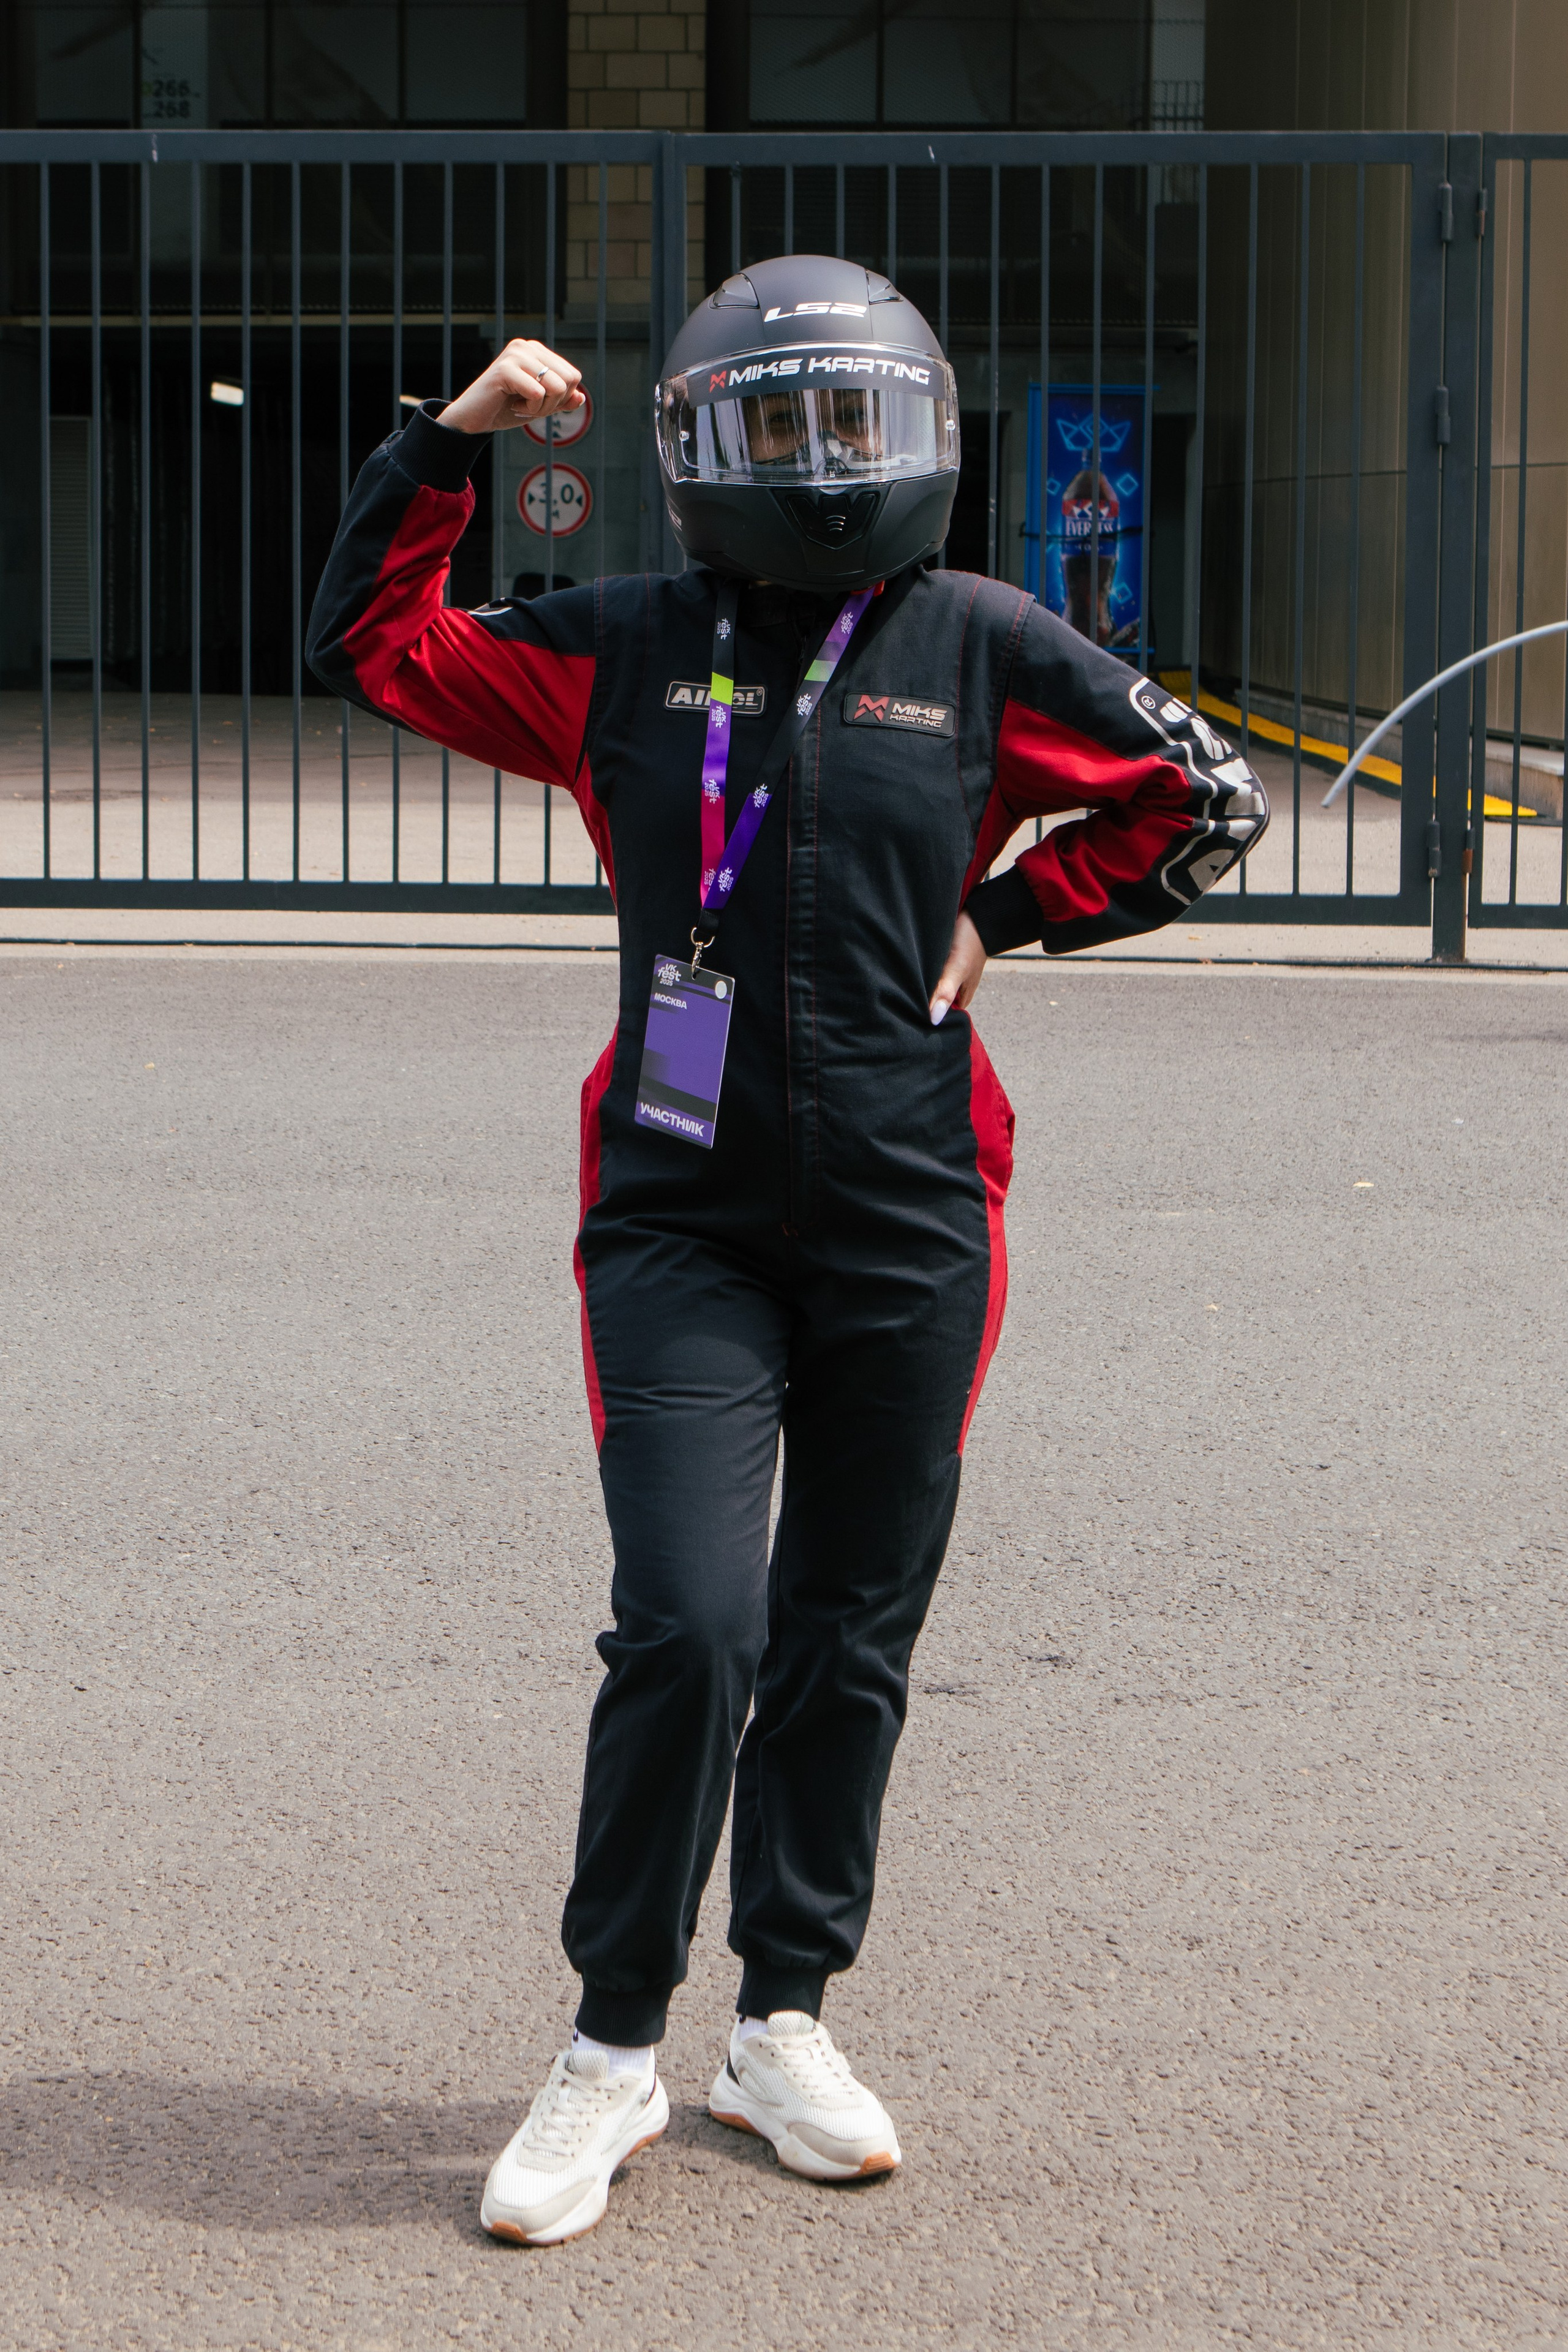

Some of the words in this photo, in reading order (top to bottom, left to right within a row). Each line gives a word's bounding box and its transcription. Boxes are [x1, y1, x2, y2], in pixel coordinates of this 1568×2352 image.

[764, 302, 867, 322] LS2
[729, 358, 803, 386] MIKS
[807, 357, 930, 386] KARTING
[889, 714, 943, 728] KARTING
[892, 703, 948, 721] MIKS
[658, 967, 682, 982] fest
[660, 978, 674, 987] 2025
[654, 992, 687, 1010] МОСКВА
[640, 1102, 704, 1137] УЧАСТНИК
